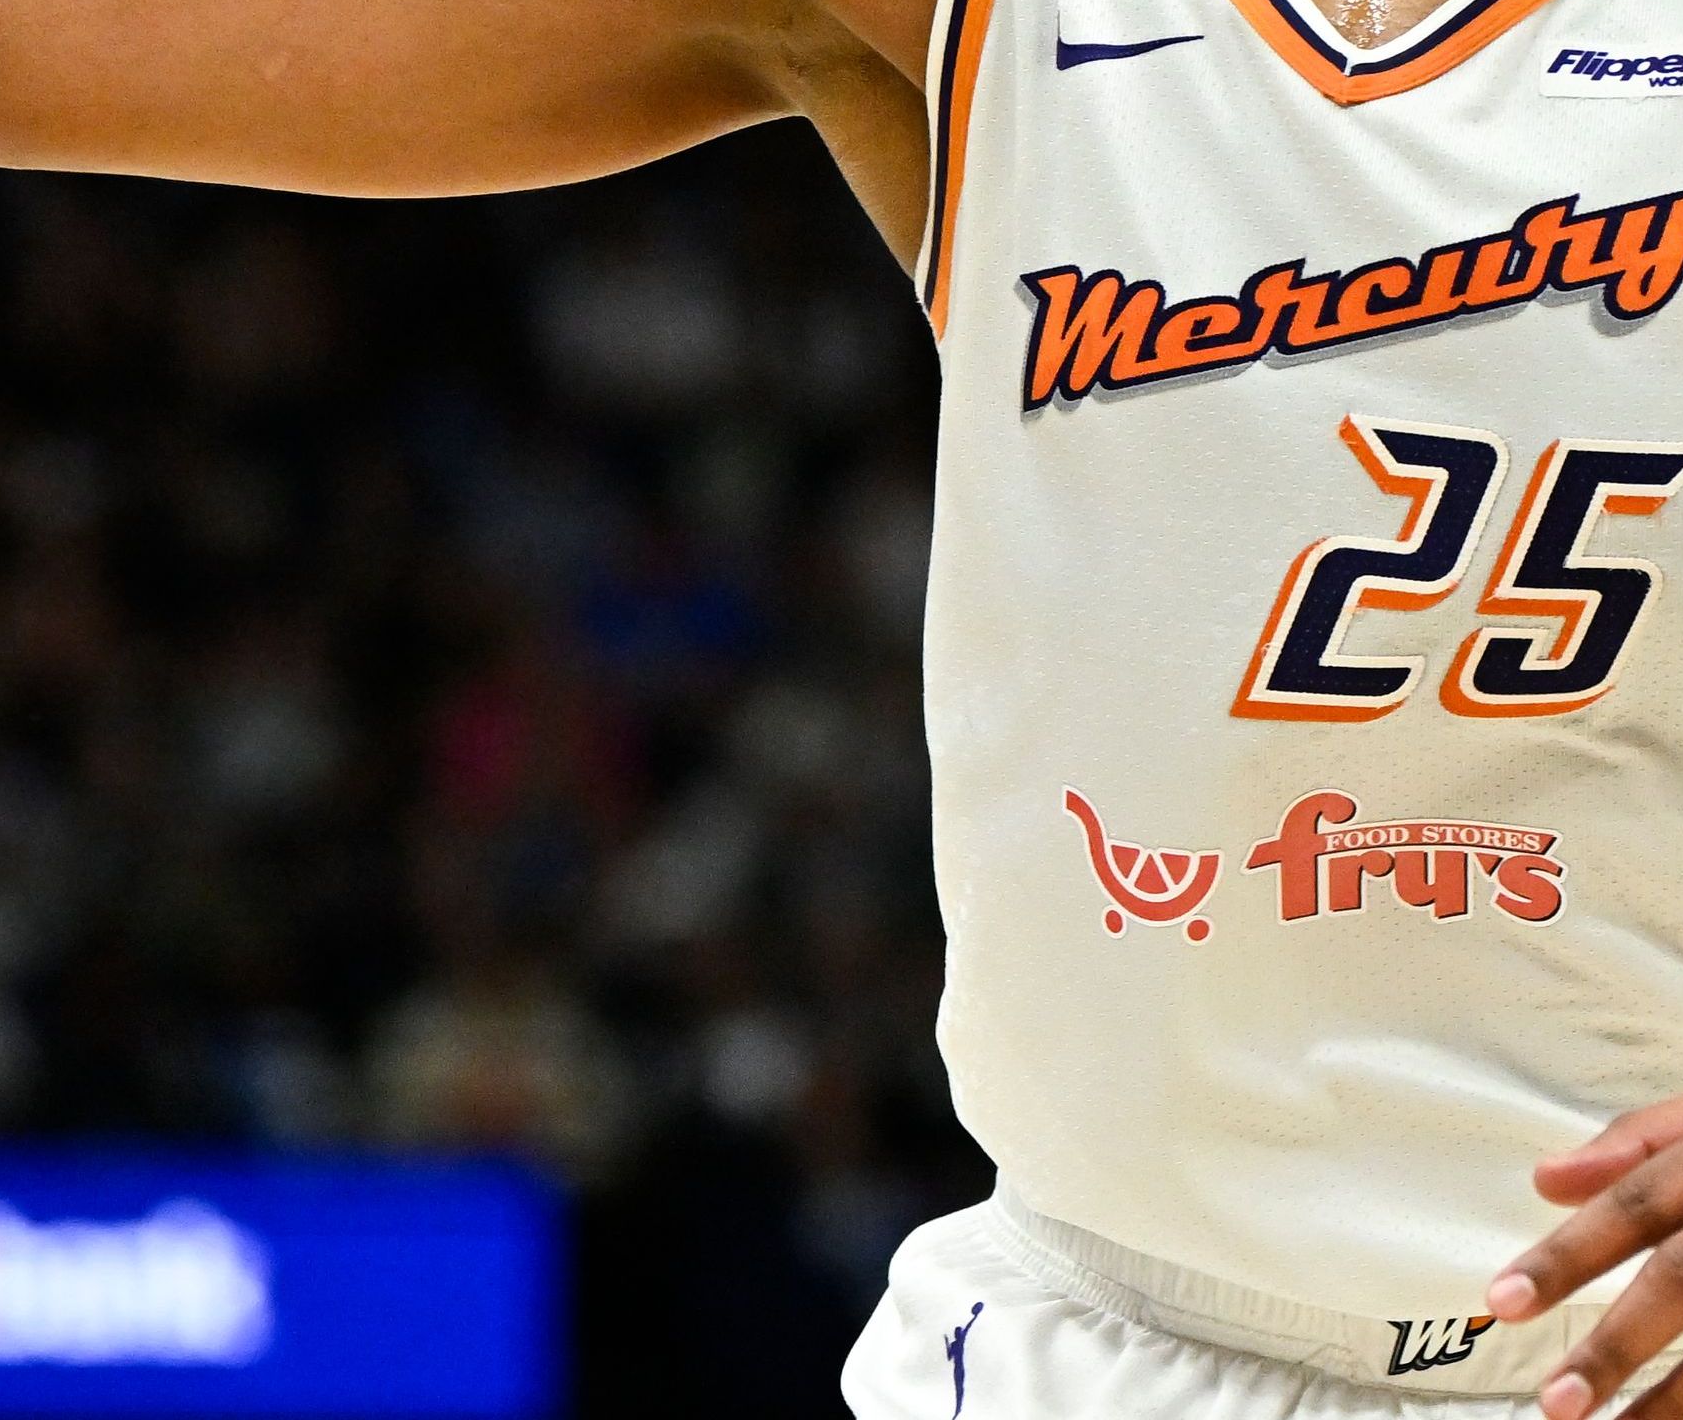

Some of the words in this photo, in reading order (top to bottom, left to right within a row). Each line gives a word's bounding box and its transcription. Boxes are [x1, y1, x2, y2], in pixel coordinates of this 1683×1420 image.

[1246, 791, 1566, 923] fry's
[1325, 828, 1410, 852] FOOD
[1421, 825, 1541, 852] STORES
